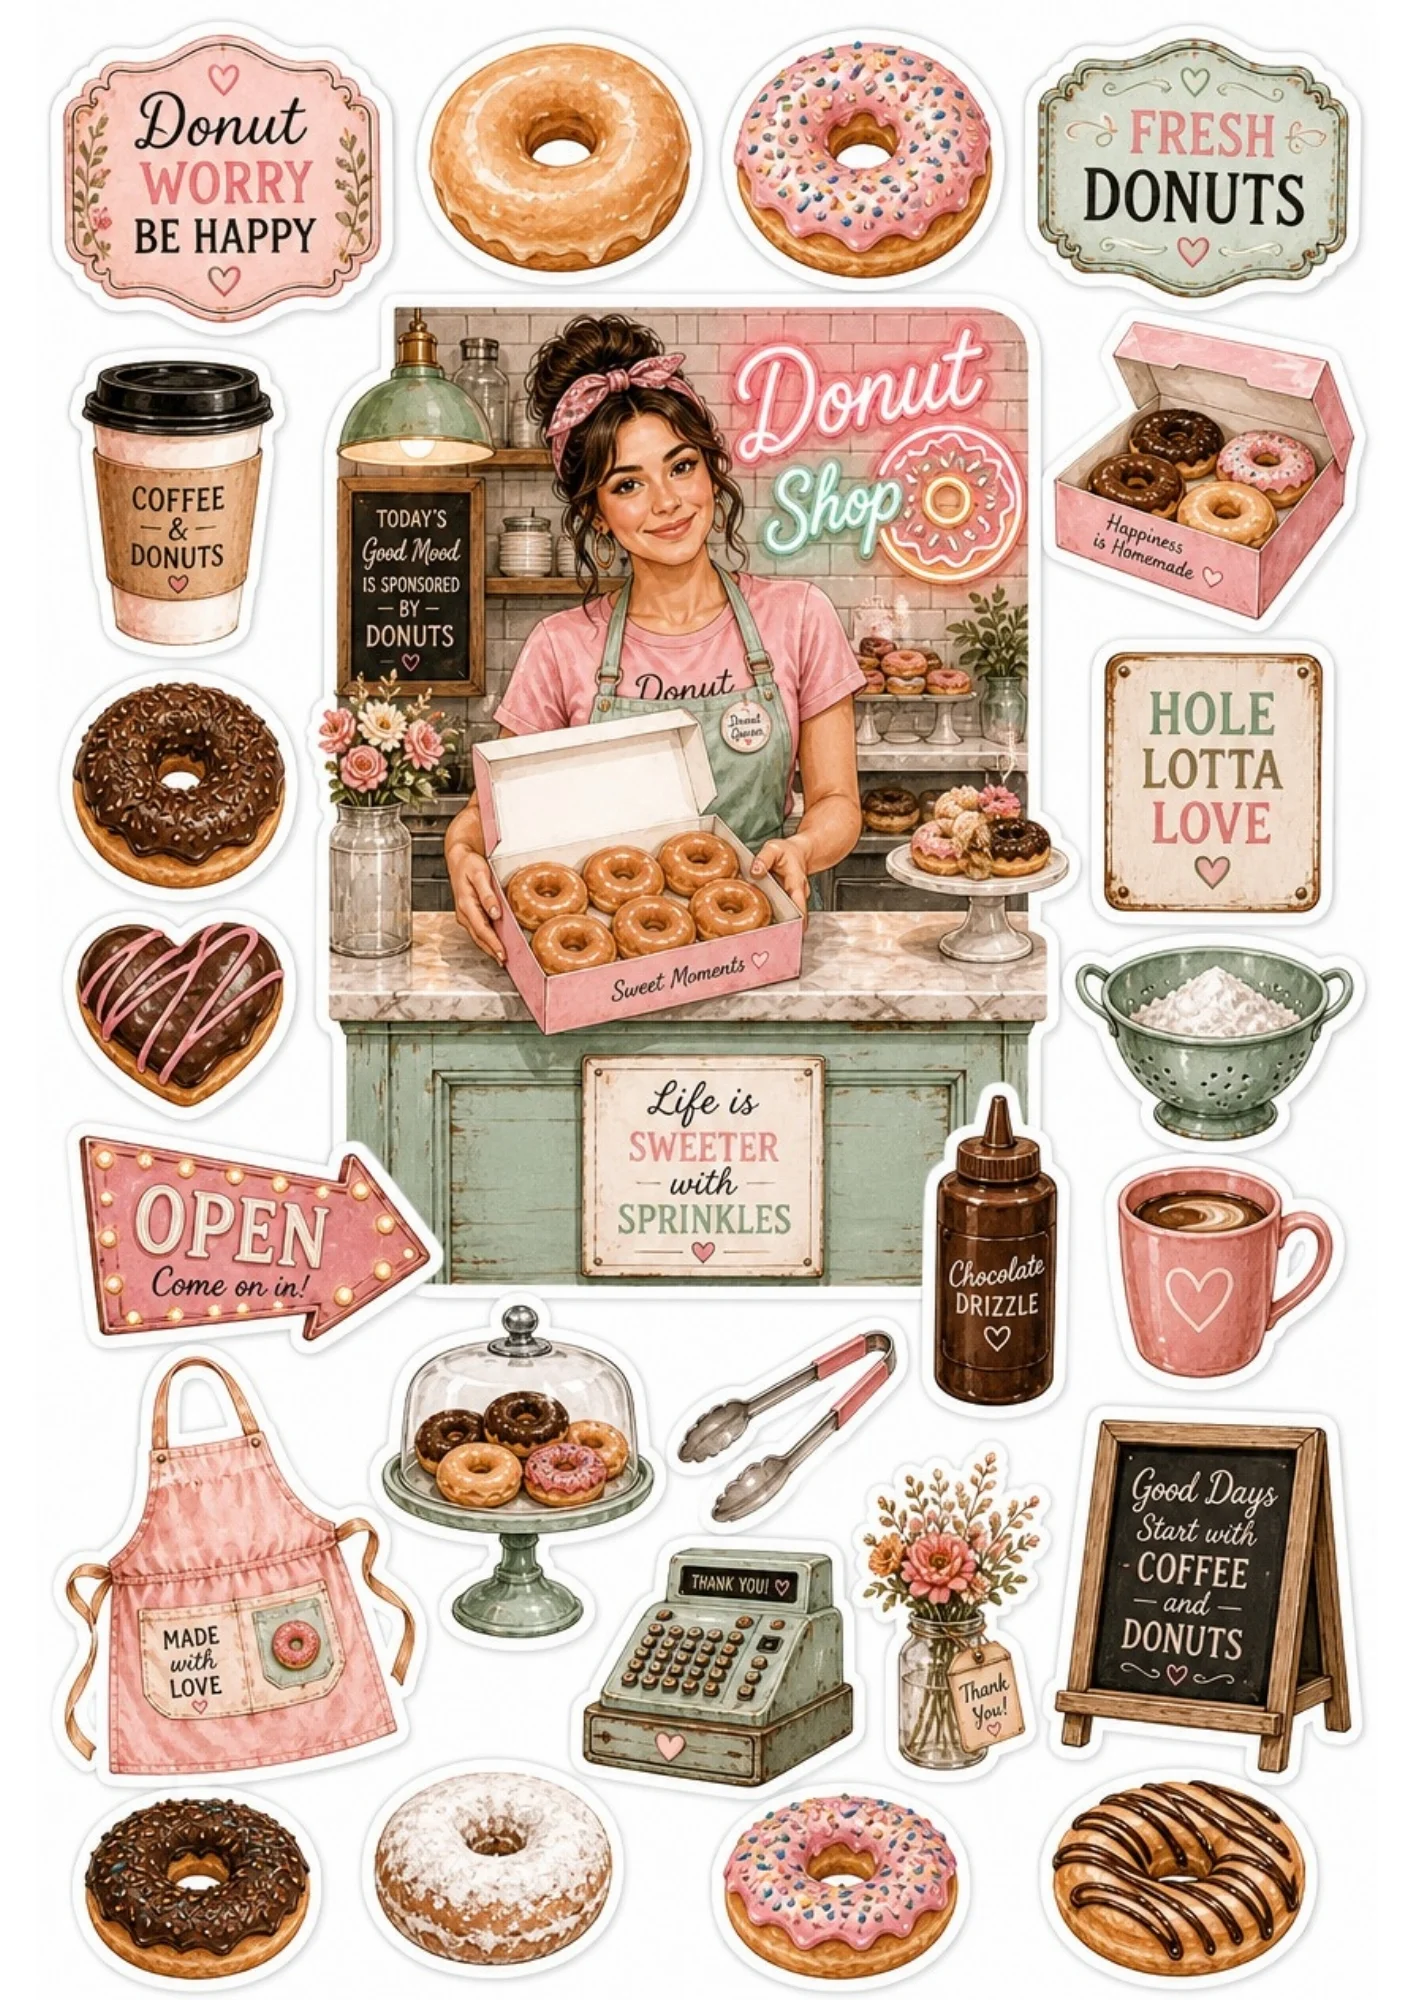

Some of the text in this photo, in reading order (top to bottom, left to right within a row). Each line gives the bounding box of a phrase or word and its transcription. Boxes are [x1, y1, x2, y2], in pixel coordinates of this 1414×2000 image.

[134, 90, 308, 150] Donut
[1130, 109, 1275, 159] FRESH
[139, 161, 314, 205] WORRY
[1083, 167, 1306, 227] DONUTS
[135, 218, 317, 254] BE HAPPY
[738, 328, 985, 460] Donut
[132, 485, 225, 512] COFFEE
[765, 461, 901, 556] Shop
[168, 517, 188, 542] &
[375, 508, 448, 529] TODAY'S
[1106, 513, 1184, 555] Happiness
[131, 544, 224, 569] DONUTS
[362, 536, 462, 571] Good Mood
[1092, 532, 1195, 580] is Homemade
[362, 576, 461, 593] IS SPONSORED
[399, 599, 421, 618] BY
[366, 624, 455, 648] DONUTS
[635, 668, 735, 700] Donut
[1149, 690, 1276, 736] HOLE
[1142, 748, 1284, 790] LOTTA
[1152, 801, 1272, 845] LOVE
[611, 956, 746, 1002] Sweet Moments
[646, 1079, 760, 1128] Life is
[629, 1131, 780, 1163] SWEETER
[669, 1166, 739, 1196] with
[135, 1183, 330, 1269] OPEN
[617, 1204, 793, 1235] SPRINKLES
[151, 1264, 312, 1299] Come on in!
[948, 1255, 1046, 1289] Chocolate
[955, 1291, 1039, 1317] DRIZZLE
[1131, 1466, 1279, 1519] Good Days
[1135, 1512, 1259, 1547] Start with
[691, 1573, 770, 1595] THANK YOU!
[1136, 1552, 1250, 1590] COFFEE
[1162, 1591, 1212, 1617] and
[163, 1625, 220, 1650] MADE
[1120, 1617, 1244, 1661] DONUTS
[170, 1648, 218, 1673] with
[170, 1675, 222, 1699] LOVE
[958, 1672, 1010, 1704] Thank
[972, 1696, 1008, 1731] You!
